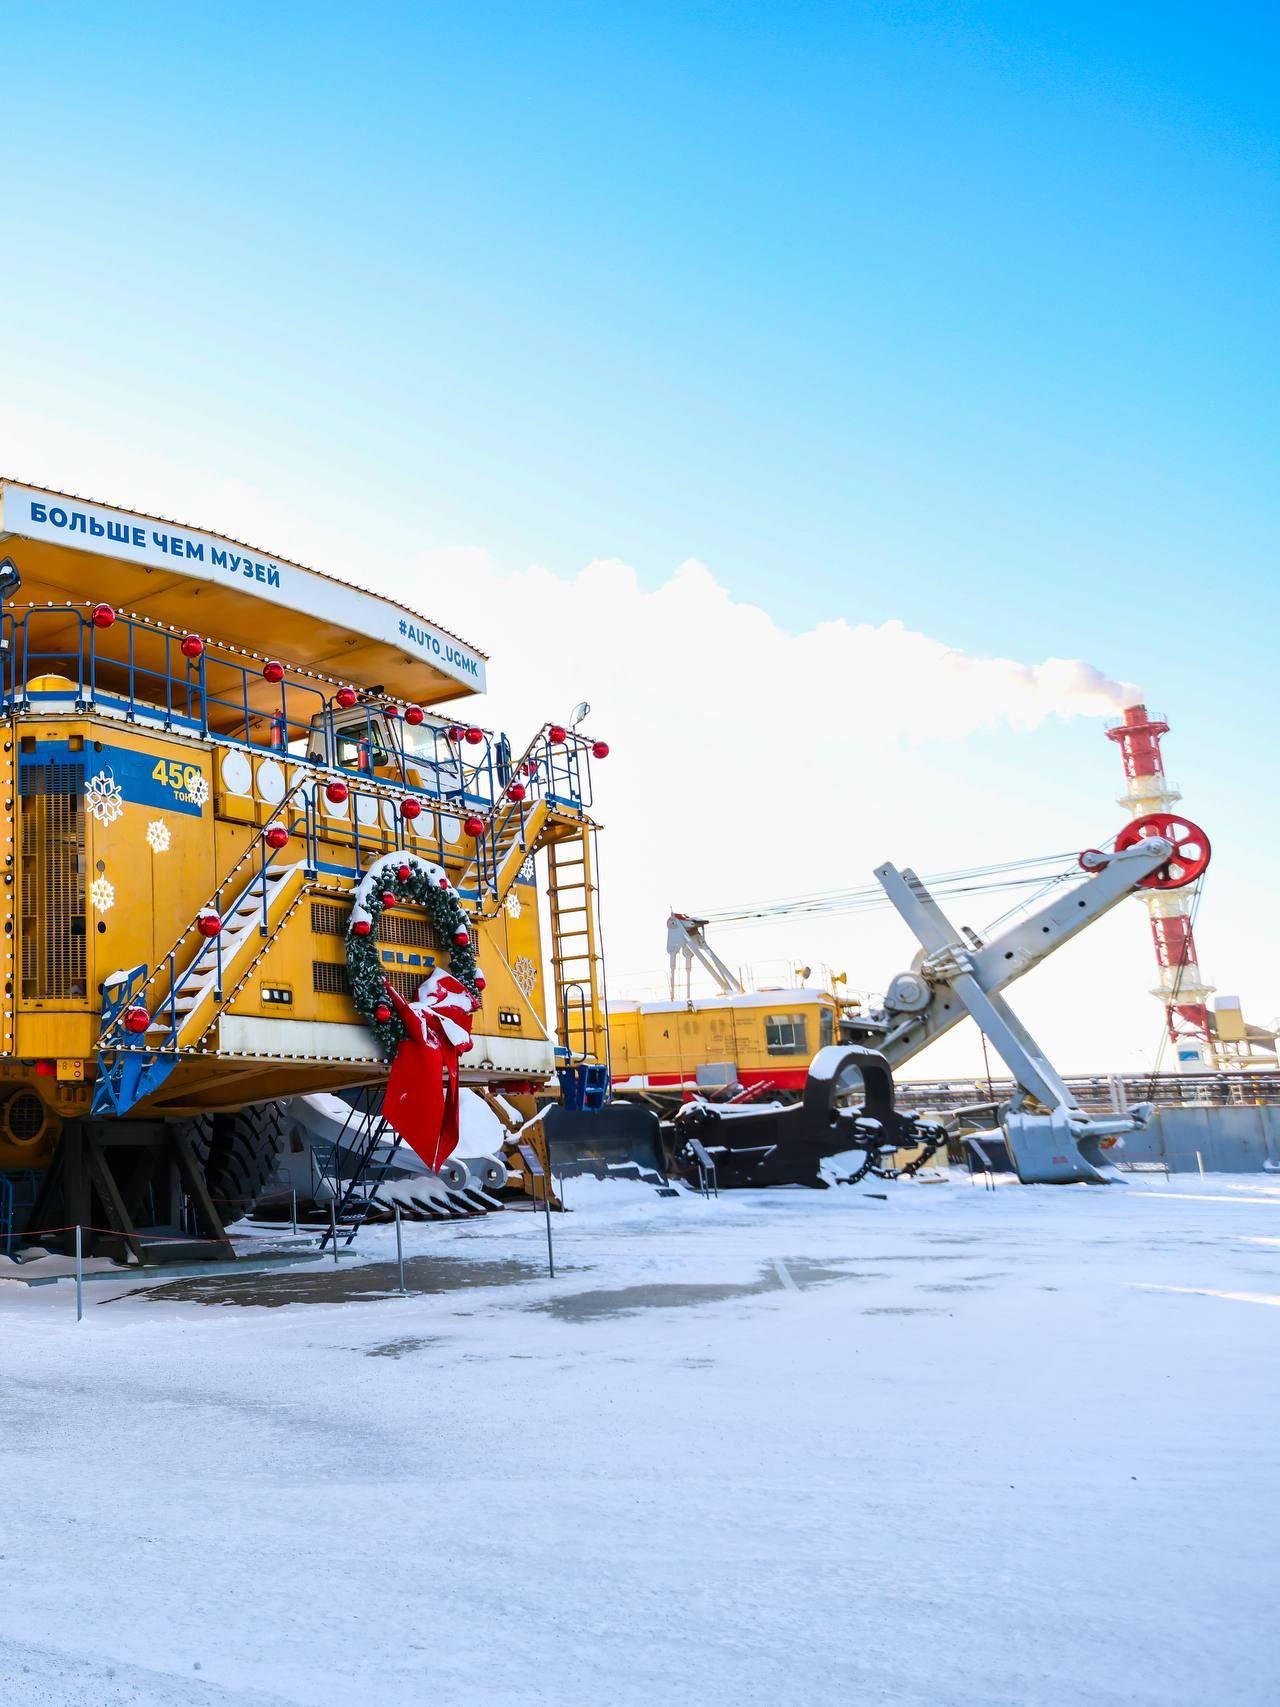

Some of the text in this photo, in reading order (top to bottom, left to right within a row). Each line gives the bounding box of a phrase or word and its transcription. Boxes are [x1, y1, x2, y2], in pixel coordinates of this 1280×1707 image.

[30, 501, 280, 588] БОЛЬШЕ ЧЕМ МУЗЕЙ
[398, 618, 479, 677] #AUTO_UGMK
[152, 759, 198, 793] 450
[382, 950, 435, 967] ELAZ
